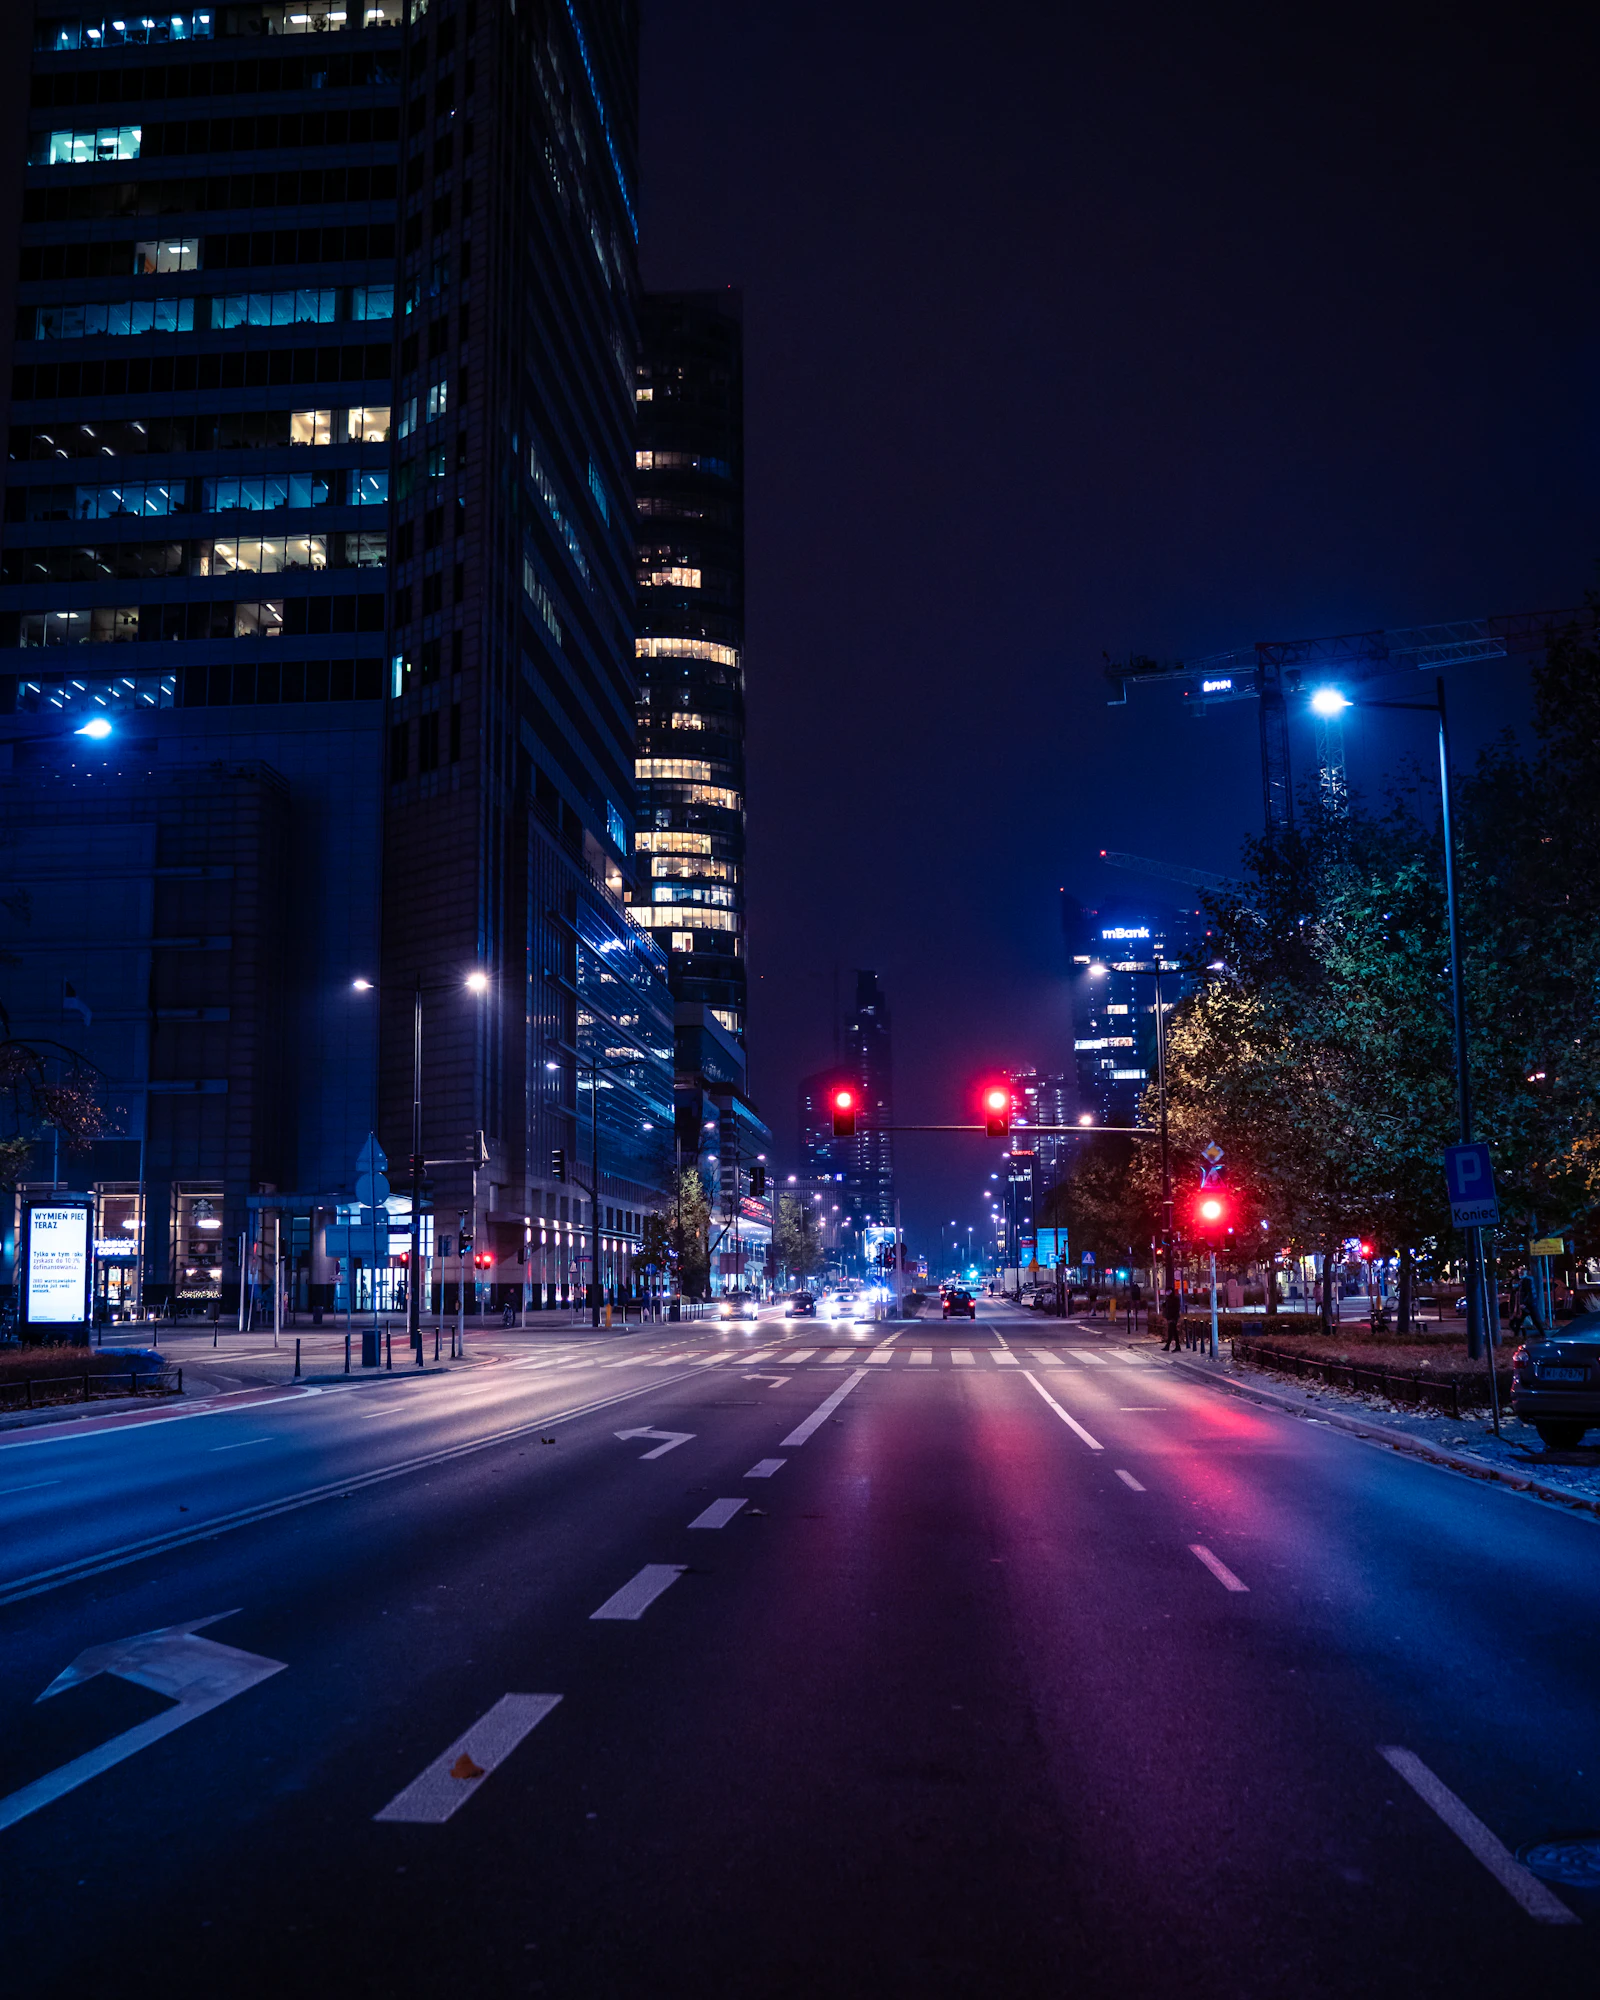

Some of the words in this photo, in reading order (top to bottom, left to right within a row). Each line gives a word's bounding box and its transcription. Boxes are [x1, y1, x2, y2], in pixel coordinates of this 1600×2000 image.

[1102, 926, 1149, 939] mBank
[1455, 1152, 1481, 1194] P
[35, 1211, 68, 1220] WYMIEŃ
[70, 1212, 84, 1220] PIEC
[1453, 1207, 1496, 1221] Koniec
[35, 1221, 57, 1229] TERAZ
[94, 1239, 139, 1248] TARBUCK
[97, 1248, 131, 1256] COFFEE
